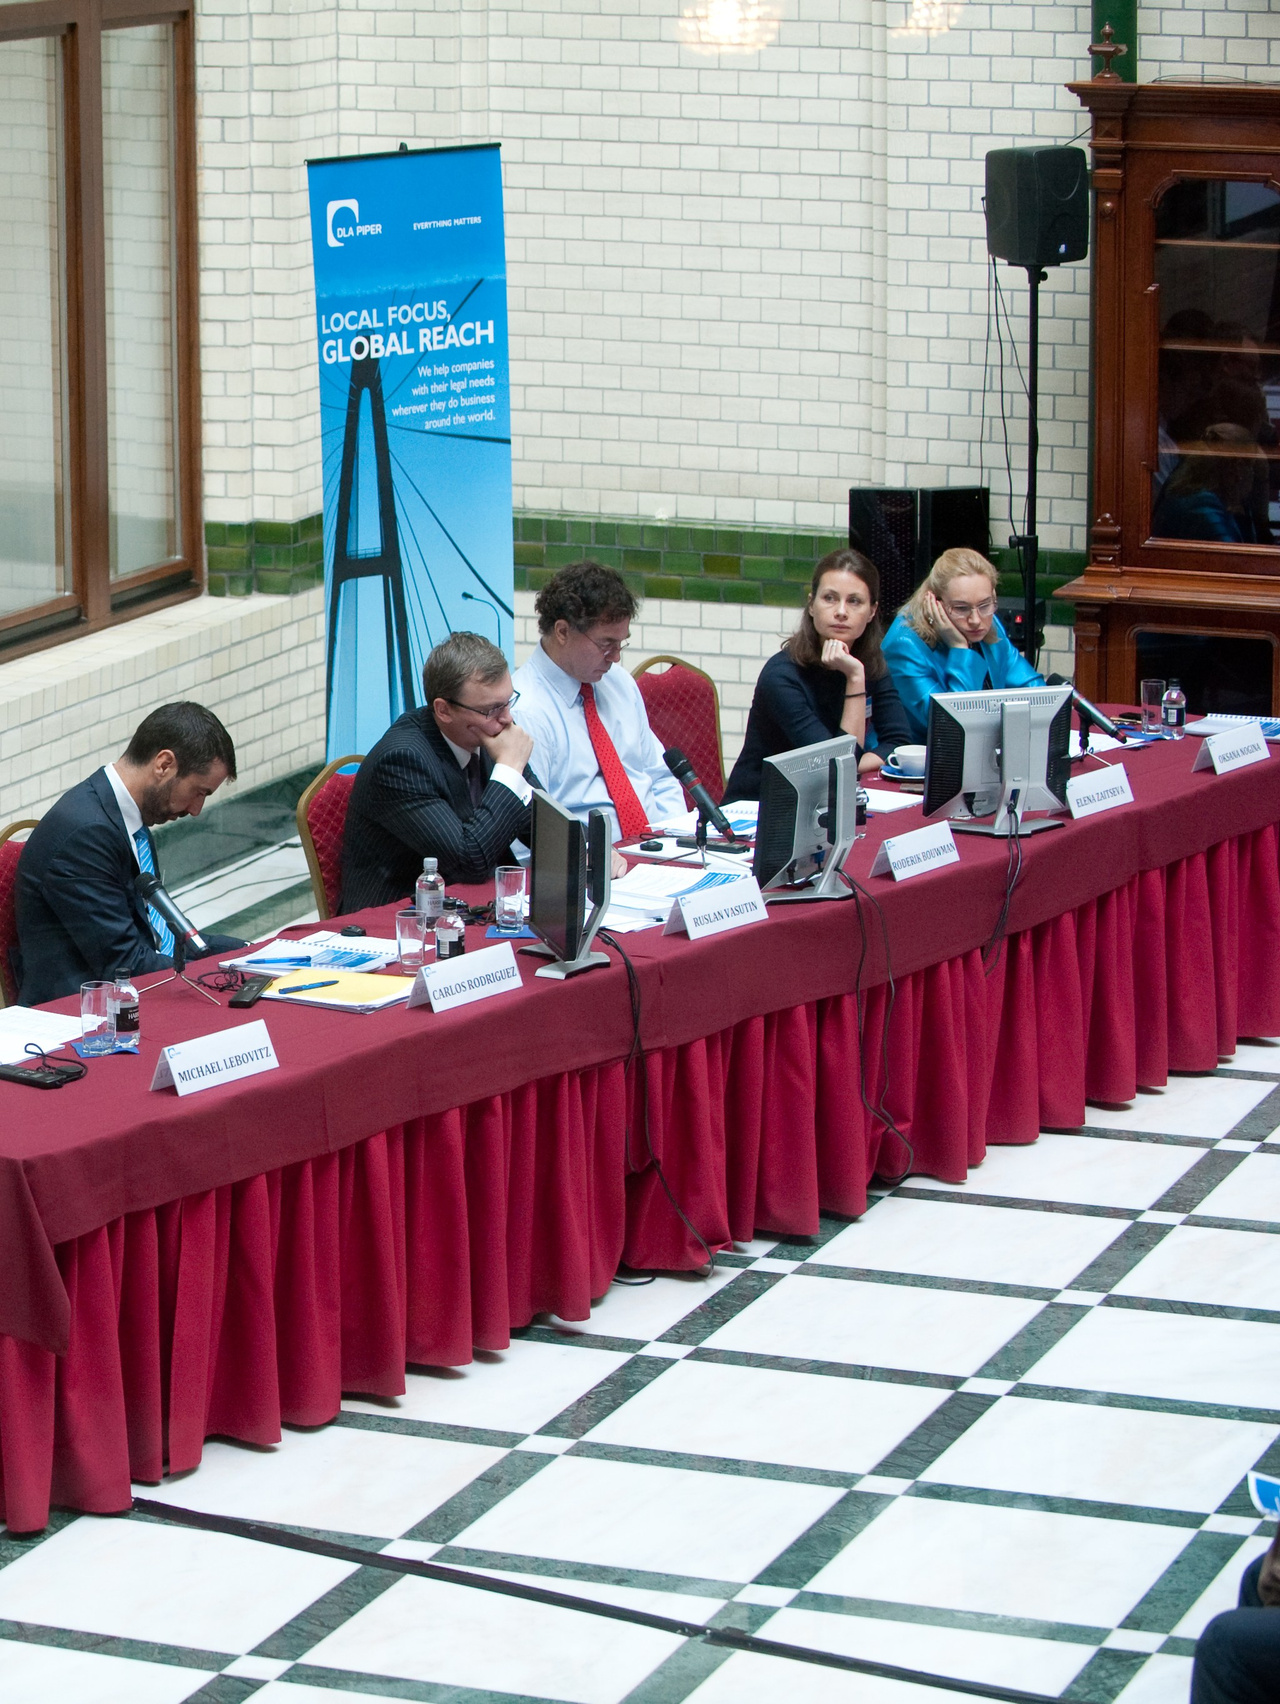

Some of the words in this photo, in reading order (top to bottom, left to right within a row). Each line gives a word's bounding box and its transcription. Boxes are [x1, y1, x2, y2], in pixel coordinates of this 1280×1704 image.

[337, 226, 354, 238] DLA
[356, 223, 383, 236] PIPER
[413, 219, 452, 231] EVERYTHING
[453, 216, 482, 226] MATTERS
[321, 308, 384, 334] LOCAL
[387, 300, 451, 326] FOCUS,
[322, 331, 414, 364] GLOBAL
[419, 320, 495, 353] REACH
[417, 366, 432, 378] We
[433, 363, 449, 379] help
[451, 359, 495, 375] companies
[411, 385, 429, 397] with
[430, 381, 449, 395] their
[450, 379, 467, 394] legal
[468, 375, 495, 388] needs
[392, 402, 428, 417] wherever
[429, 399, 446, 414] they
[448, 397, 459, 409] do
[460, 393, 496, 407] business
[424, 415, 451, 430] around
[453, 413, 466, 426] the
[467, 408, 496, 423] world.
[1218, 749, 1241, 764] OKSANA
[1075, 794, 1097, 808] ELENA
[1096, 785, 1126, 802] ZAITSEVA
[891, 853, 923, 872] RODERIK
[921, 842, 956, 862] BOUWMAN
[692, 910, 725, 928] RUSLAN
[724, 900, 759, 919] VASUTIN
[432, 981, 467, 1001] CARLOS
[467, 966, 518, 991] RODRIGUEZ
[177, 1061, 224, 1083] MICHAEL
[223, 1046, 272, 1070] LEBOVITZ
